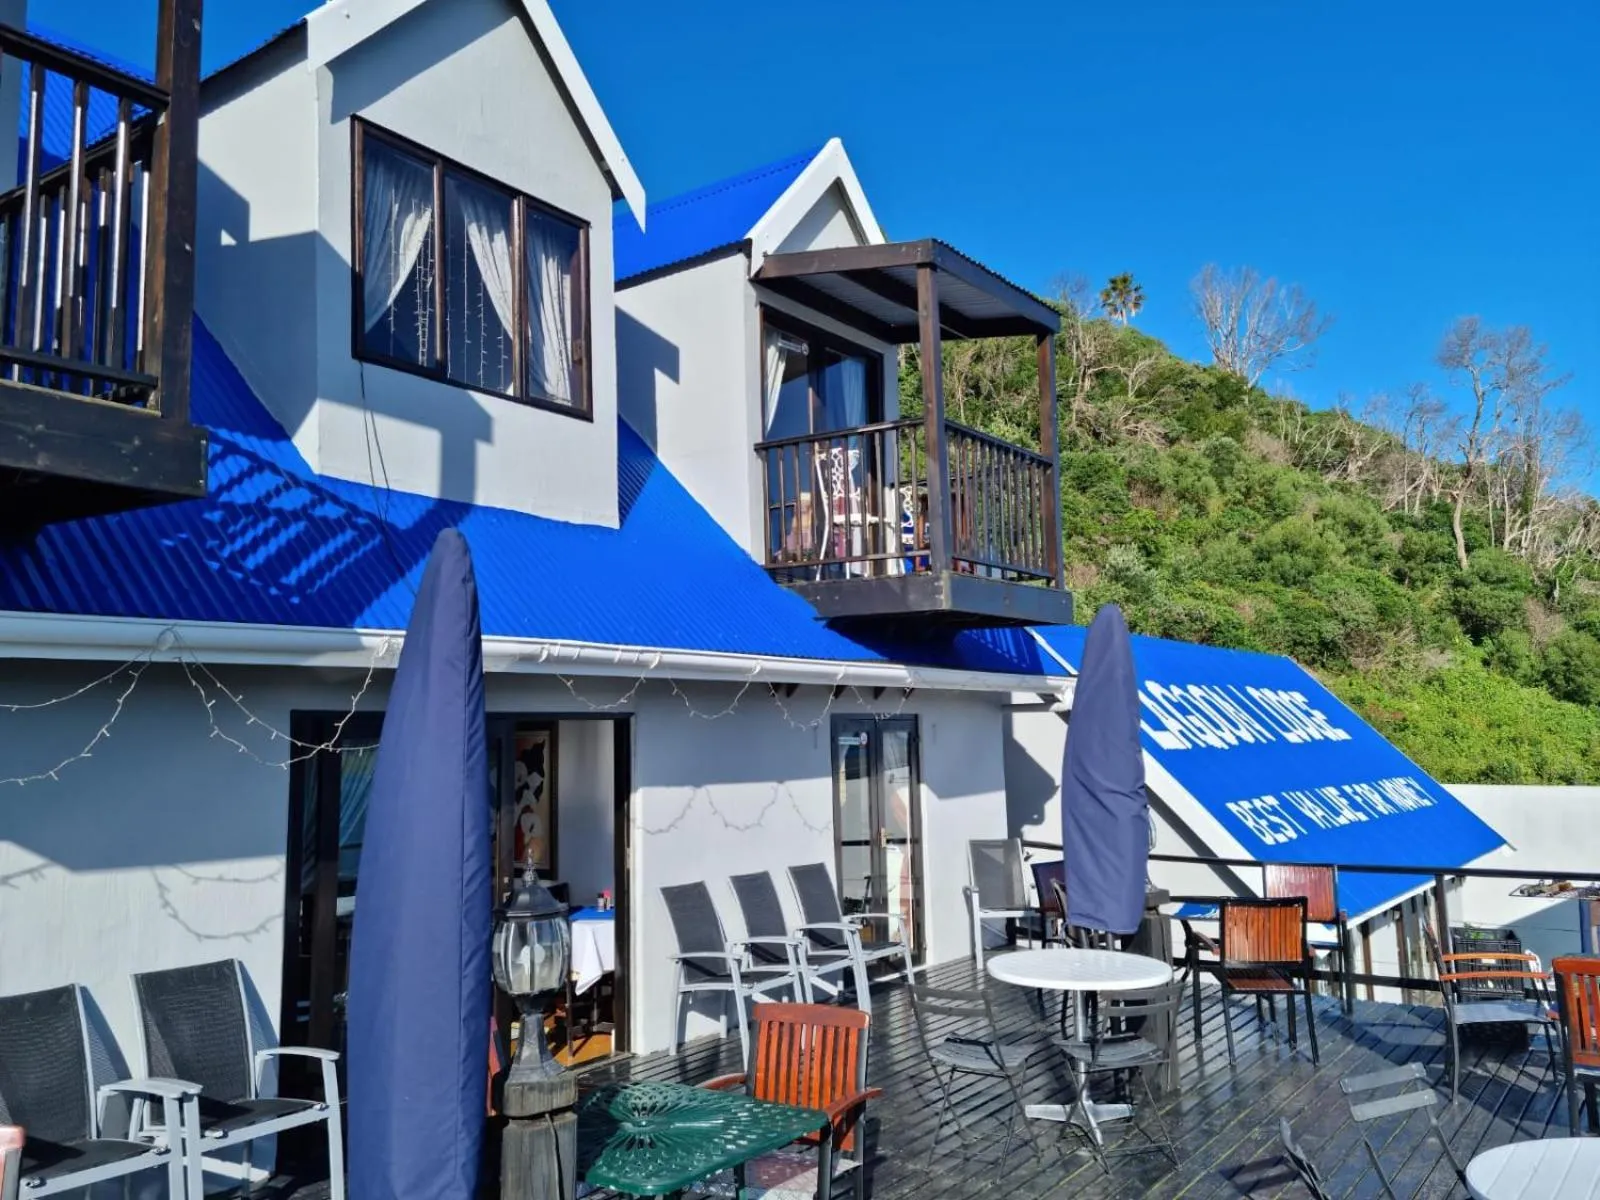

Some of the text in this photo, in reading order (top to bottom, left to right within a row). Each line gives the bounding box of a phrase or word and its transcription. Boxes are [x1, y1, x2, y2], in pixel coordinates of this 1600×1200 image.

[1138, 680, 1352, 749] LAGOON LODGE
[1225, 776, 1438, 845] BEST VALUE FOR MONEY
